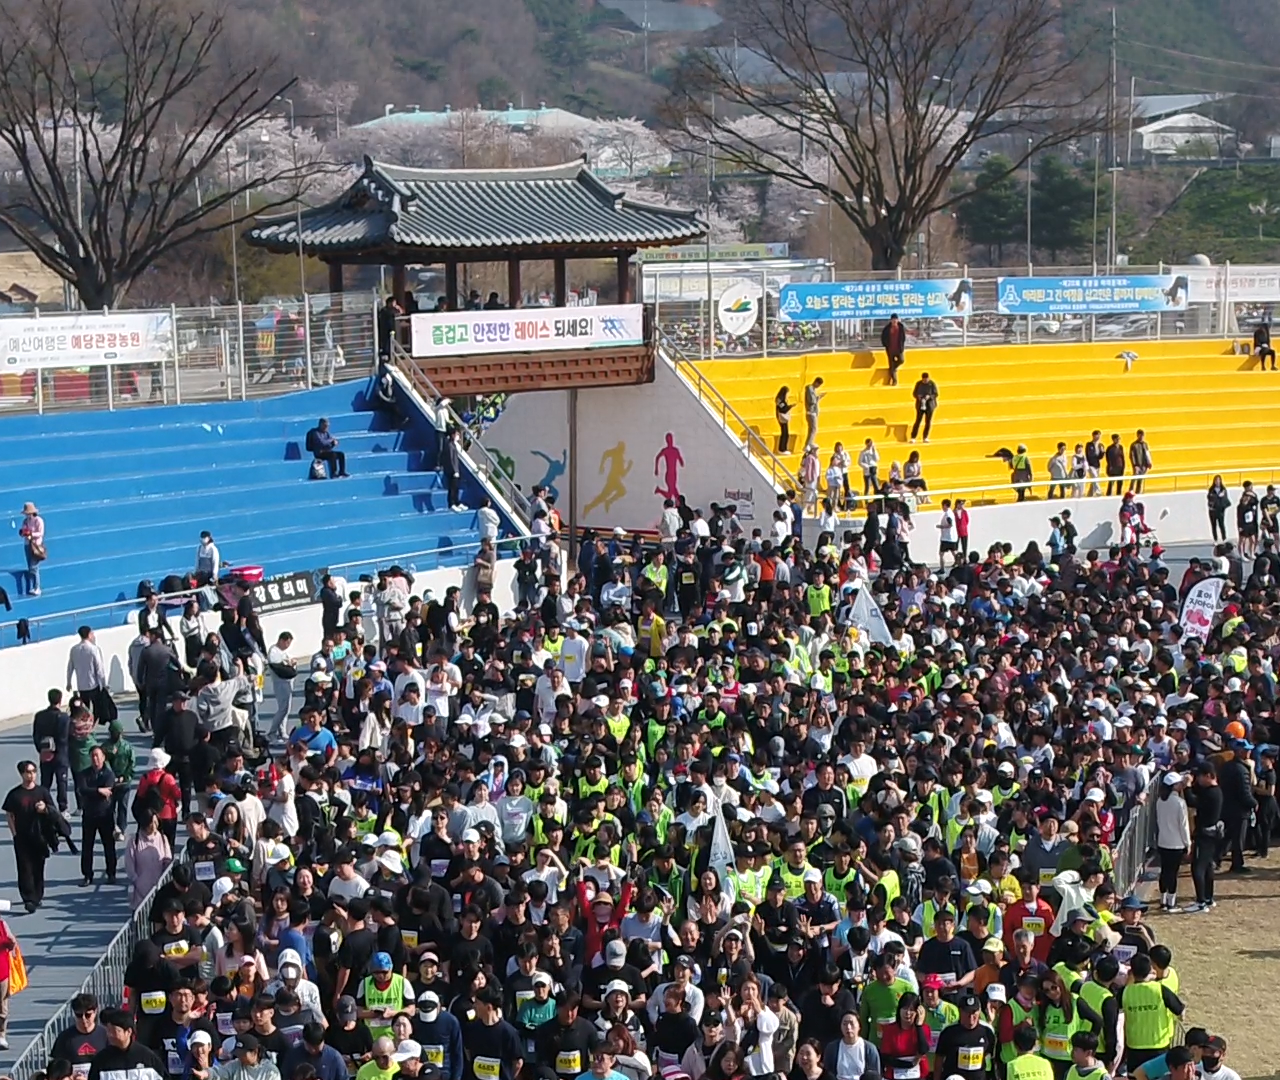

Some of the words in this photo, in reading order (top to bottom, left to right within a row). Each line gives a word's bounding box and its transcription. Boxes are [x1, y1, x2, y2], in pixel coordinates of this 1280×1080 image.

[9, 335, 68, 353] 예산여행은
[72, 331, 140, 350] 예당관광농원
[432, 325, 468, 345] 즐겁고
[473, 322, 510, 343] 안전한
[514, 320, 551, 340] 레이스
[554, 318, 593, 338] 되세요!
